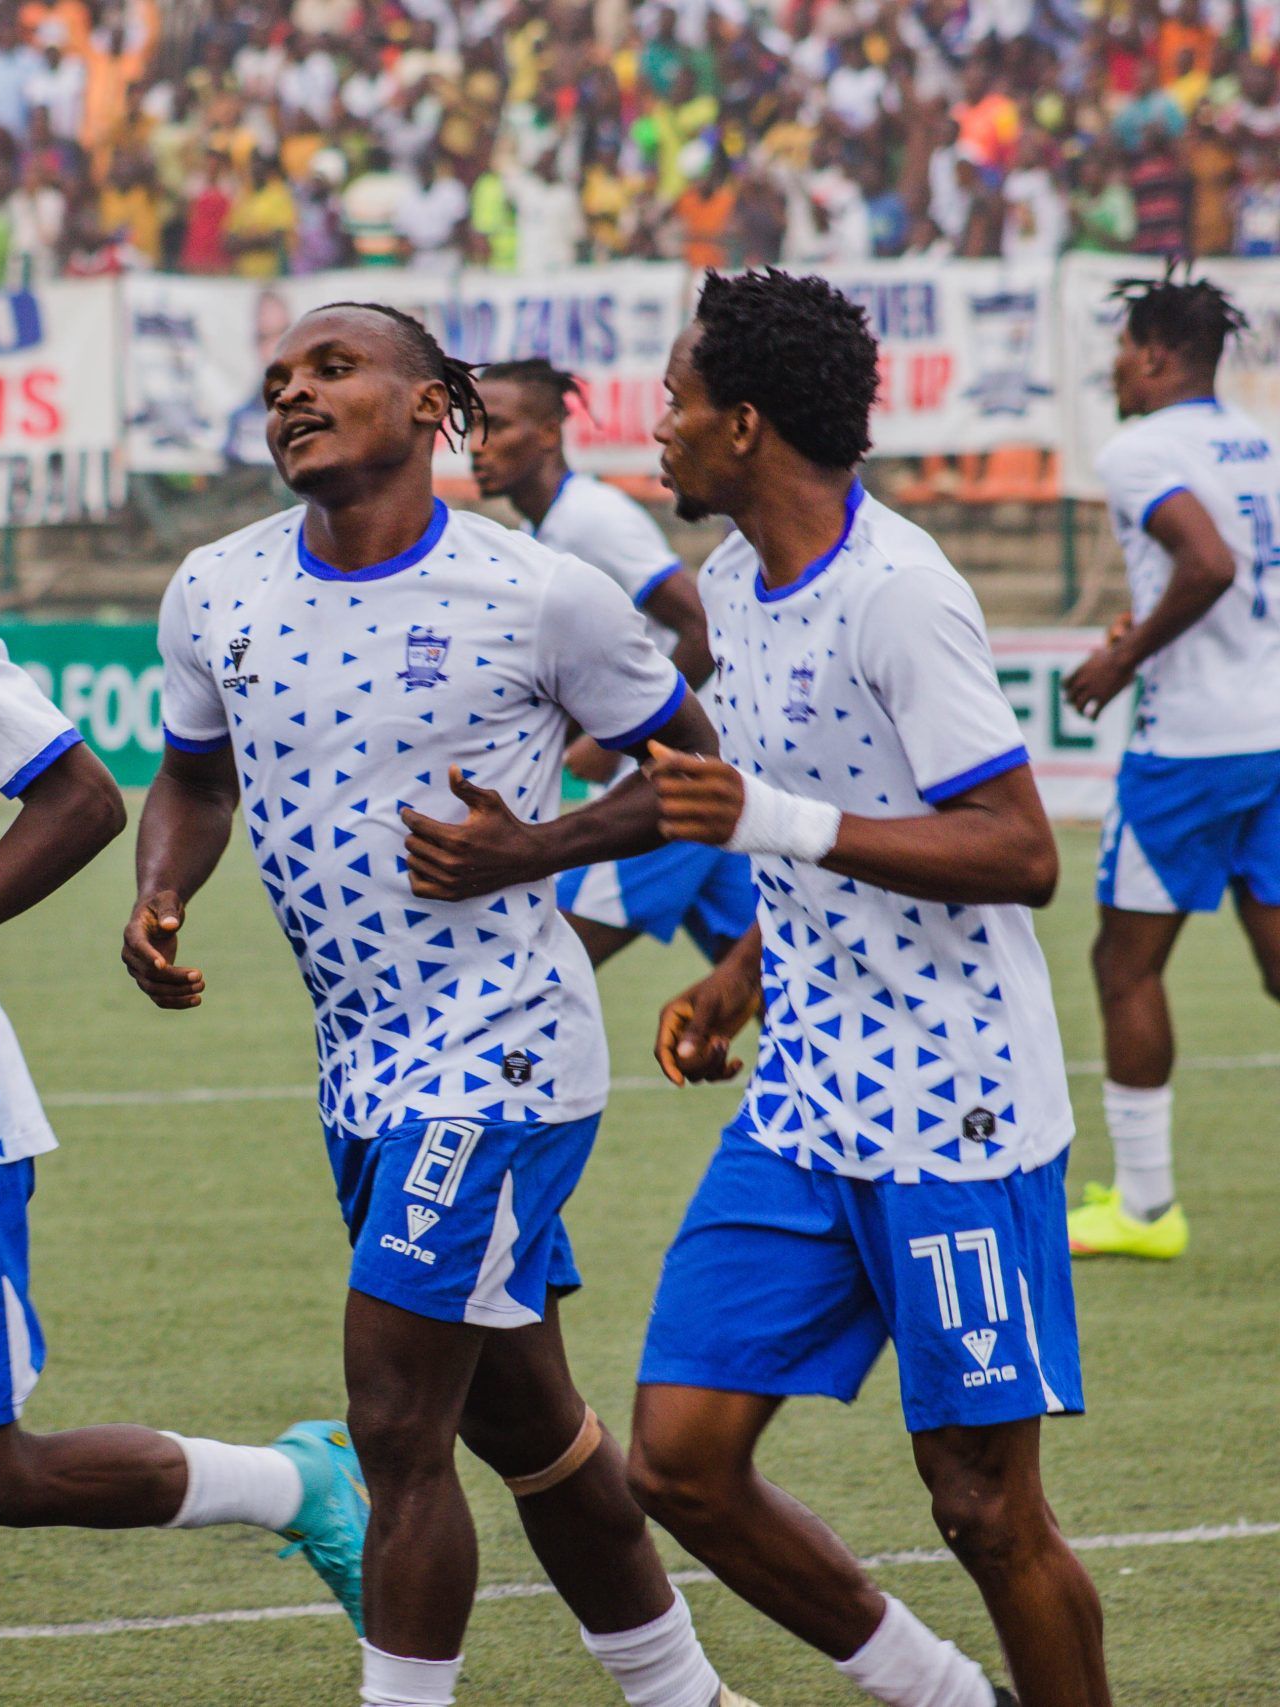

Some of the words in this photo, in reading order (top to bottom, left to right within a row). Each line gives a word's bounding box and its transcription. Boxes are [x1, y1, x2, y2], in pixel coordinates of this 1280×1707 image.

[61, 661, 165, 752] FOO
[402, 1119, 485, 1208] 8
[379, 1234, 437, 1265] cone
[908, 1227, 1009, 1330] 77
[963, 1365, 1018, 1388] cone
